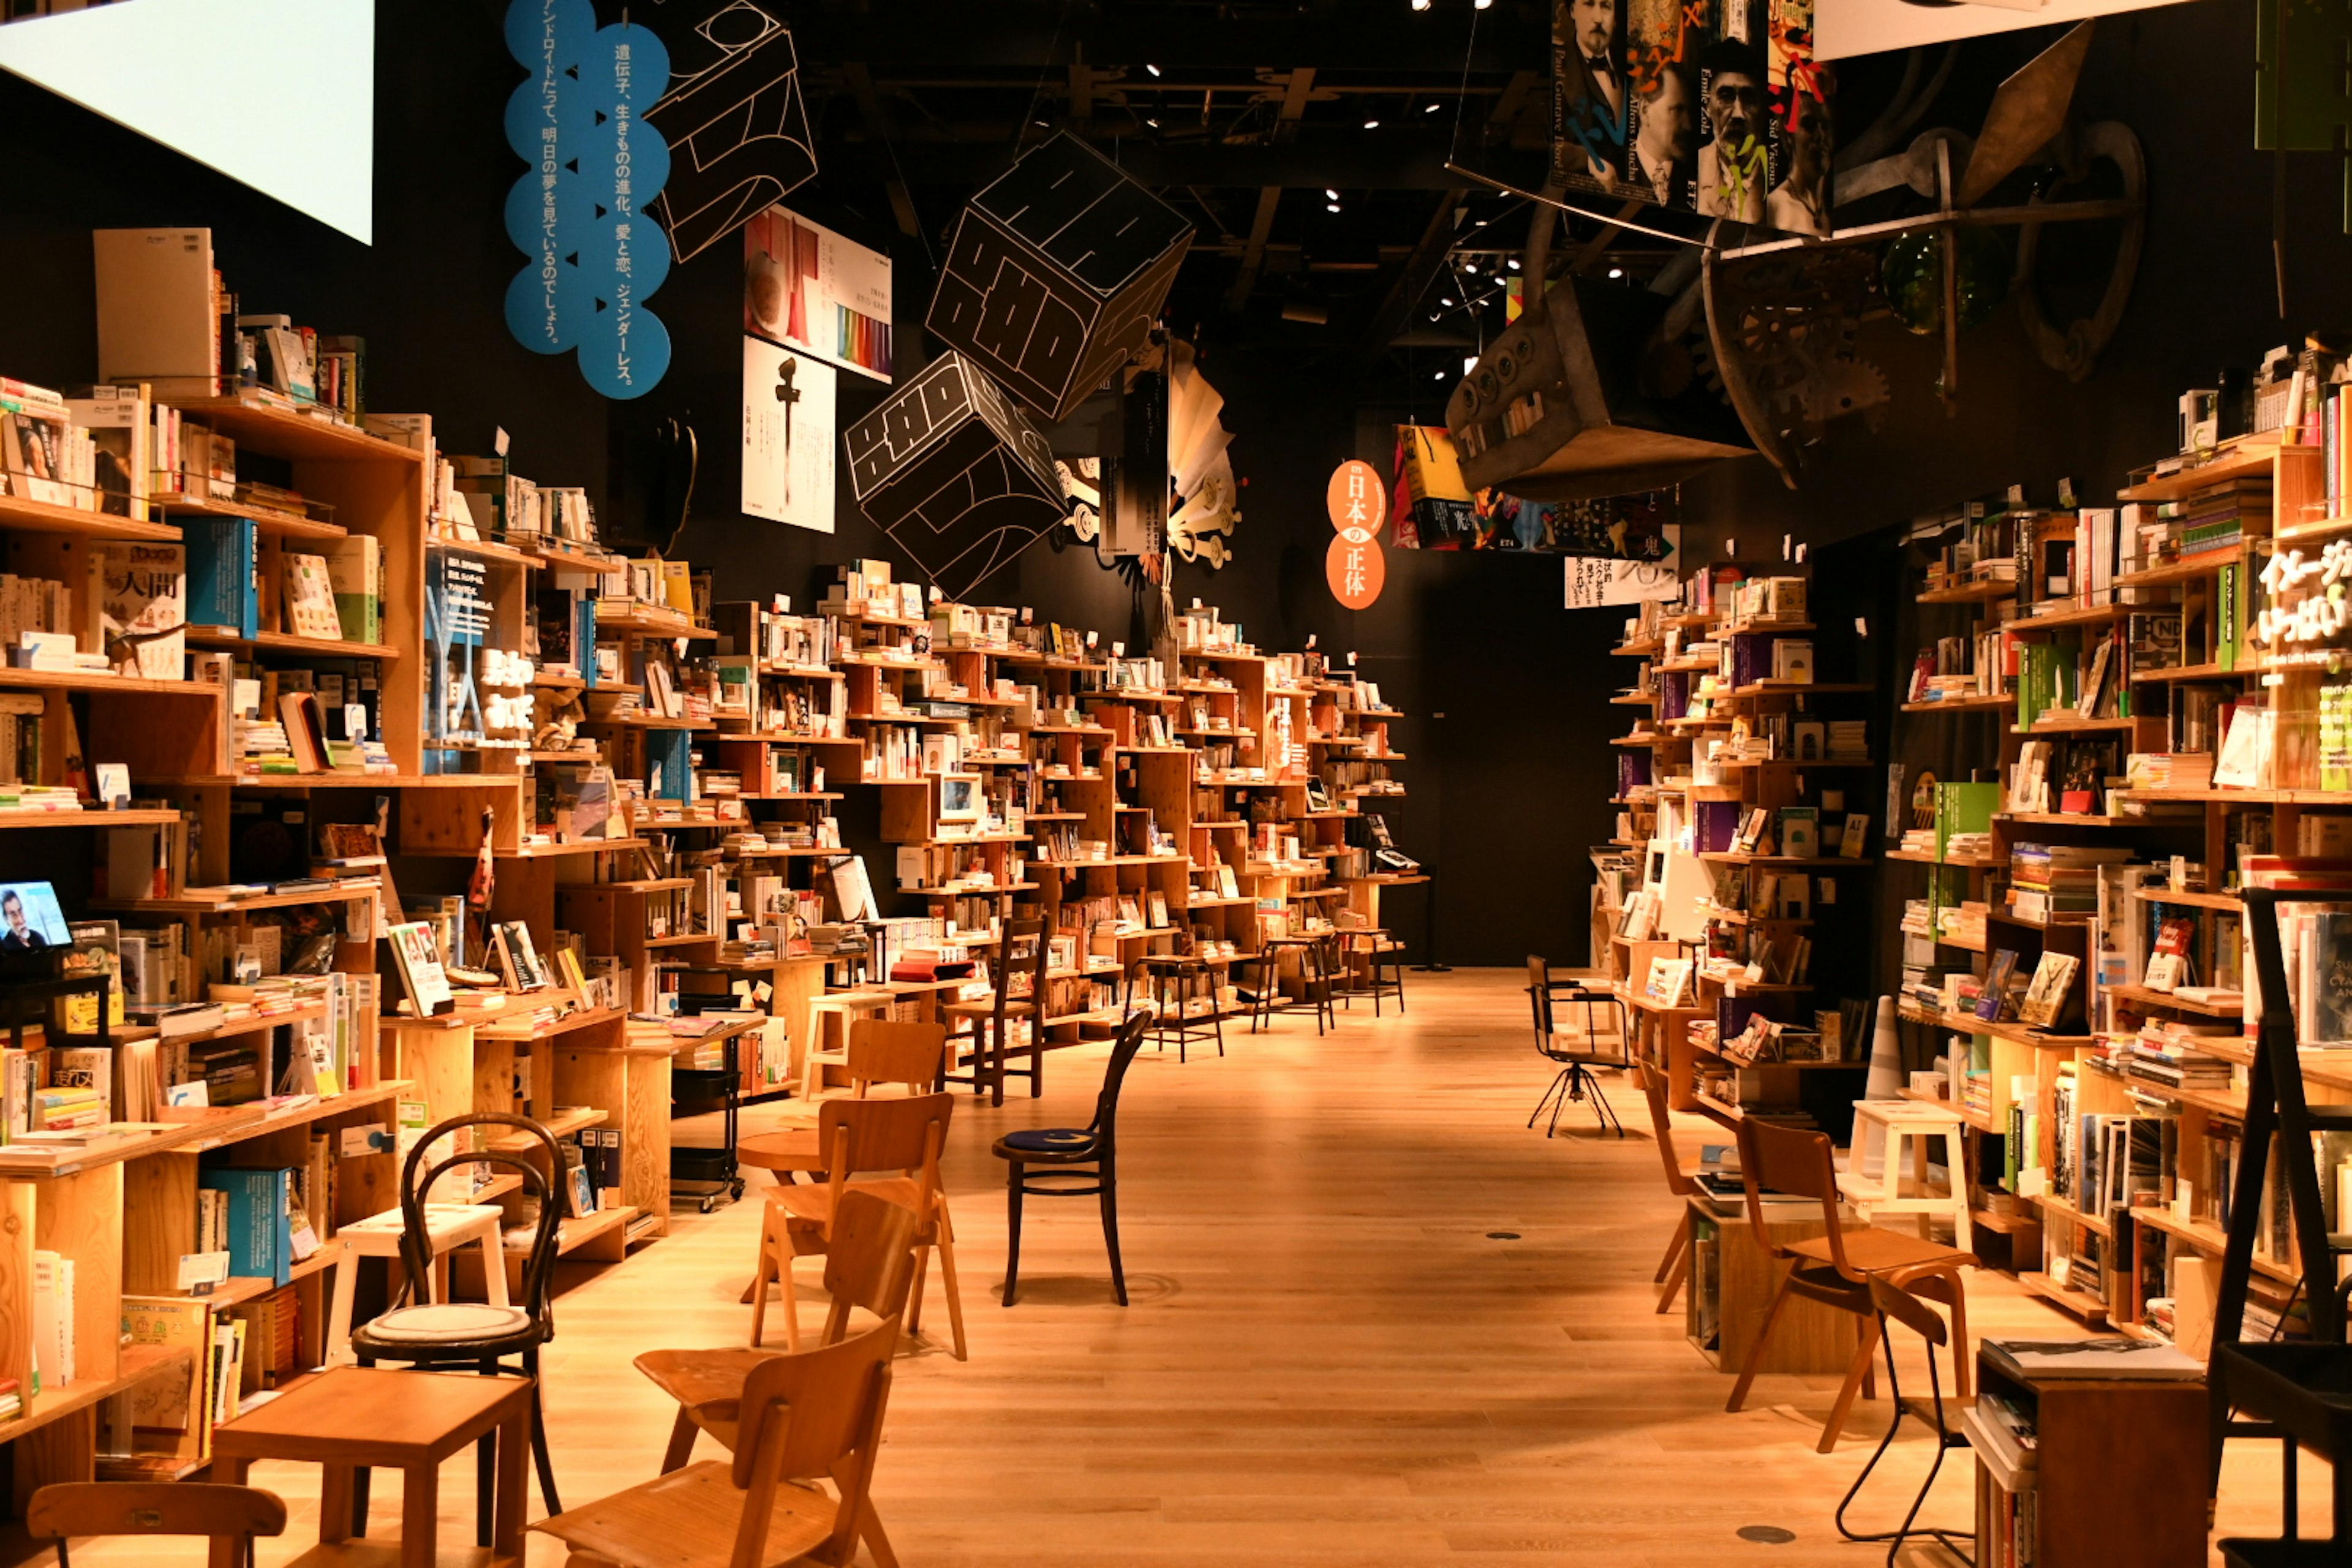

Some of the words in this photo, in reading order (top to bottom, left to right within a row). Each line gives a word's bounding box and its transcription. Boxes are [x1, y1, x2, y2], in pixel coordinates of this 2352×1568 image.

[1556, 50, 1566, 79] Paul
[1700, 107, 1713, 135] Zola
[1768, 118, 1779, 138] Sid
[1768, 141, 1779, 187] Vicious
[614, 45, 633, 387] 遺伝子、生きものの進化、愛と恋、ジェンダーレス。
[1343, 475, 1367, 597] 日本の正体
[118, 571, 178, 598] 人間
